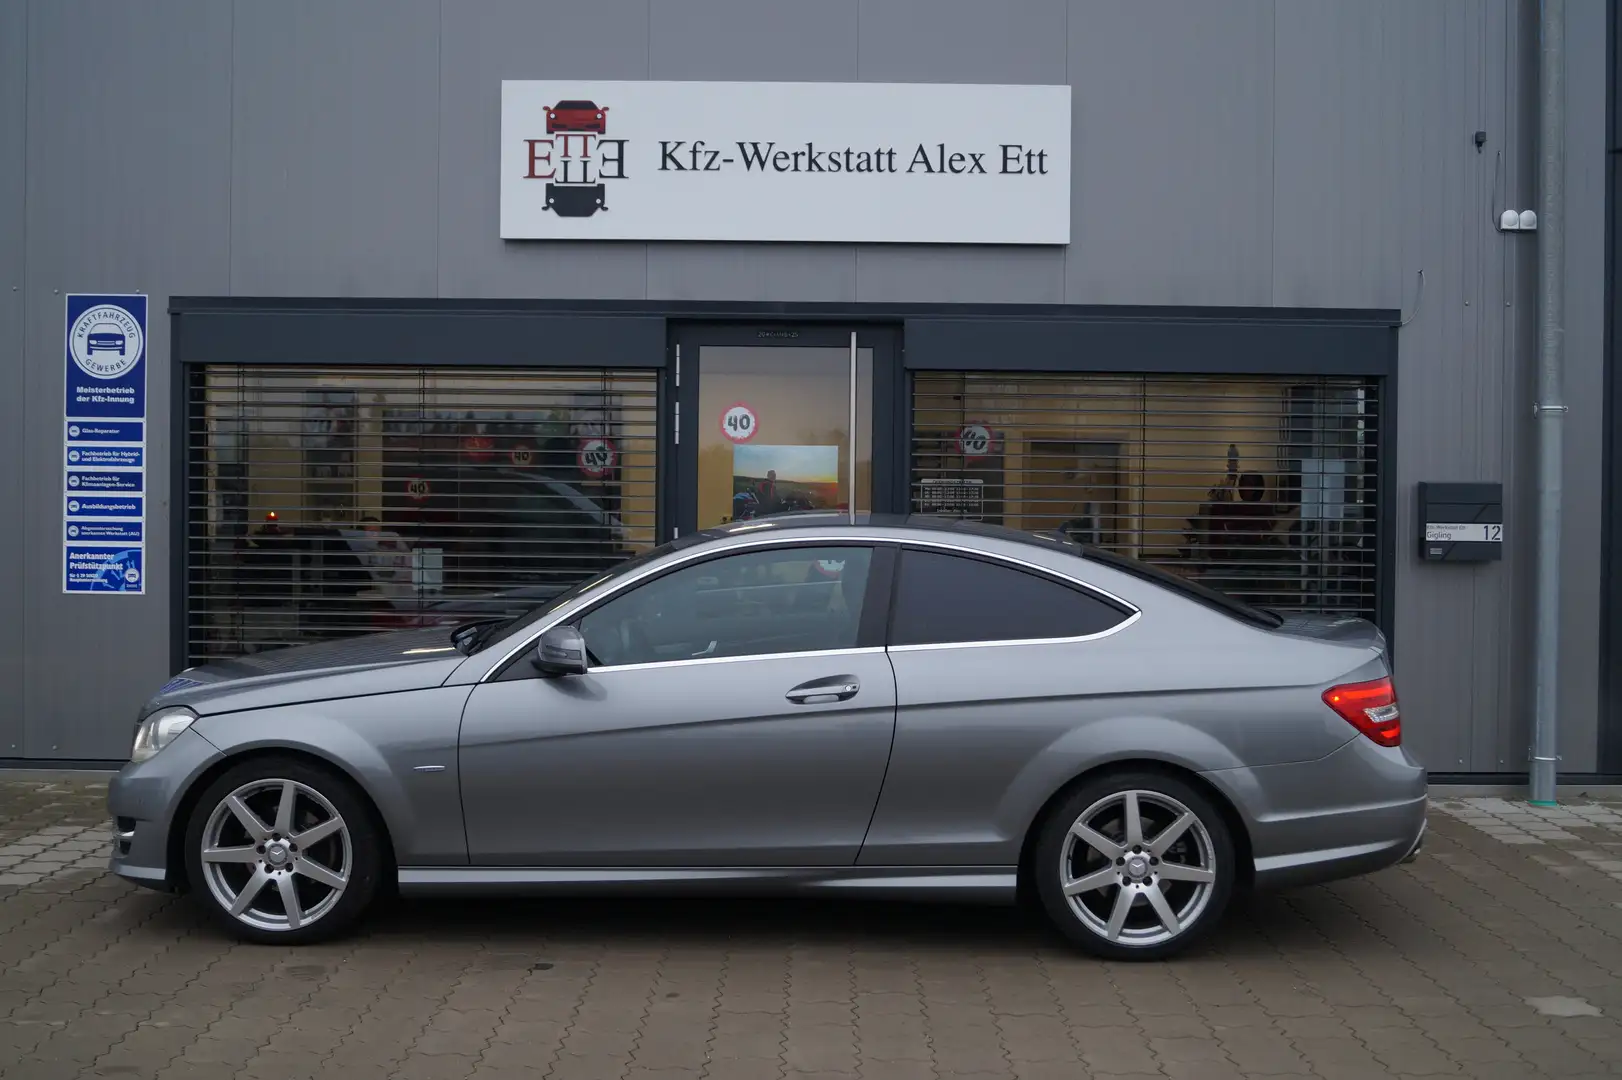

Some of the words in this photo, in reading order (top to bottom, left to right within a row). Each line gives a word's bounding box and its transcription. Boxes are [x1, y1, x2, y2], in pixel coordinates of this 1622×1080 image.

[657, 140, 897, 173] Kfz-Werkstatt
[906, 143, 987, 174] Alex
[998, 144, 1049, 175] Ett
[77, 311, 136, 339] KRAFTFAHRZEUG
[85, 358, 126, 373] GEWERBE
[76, 386, 135, 394] Meisterbetrieb
[91, 395, 135, 404] Kfz-Innung
[727, 413, 751, 432] 40
[1426, 531, 1452, 540] Gigling
[1483, 525, 1501, 540] 12
[69, 551, 115, 560] Anerkannter
[69, 561, 124, 571] Prüfstützpunkt
